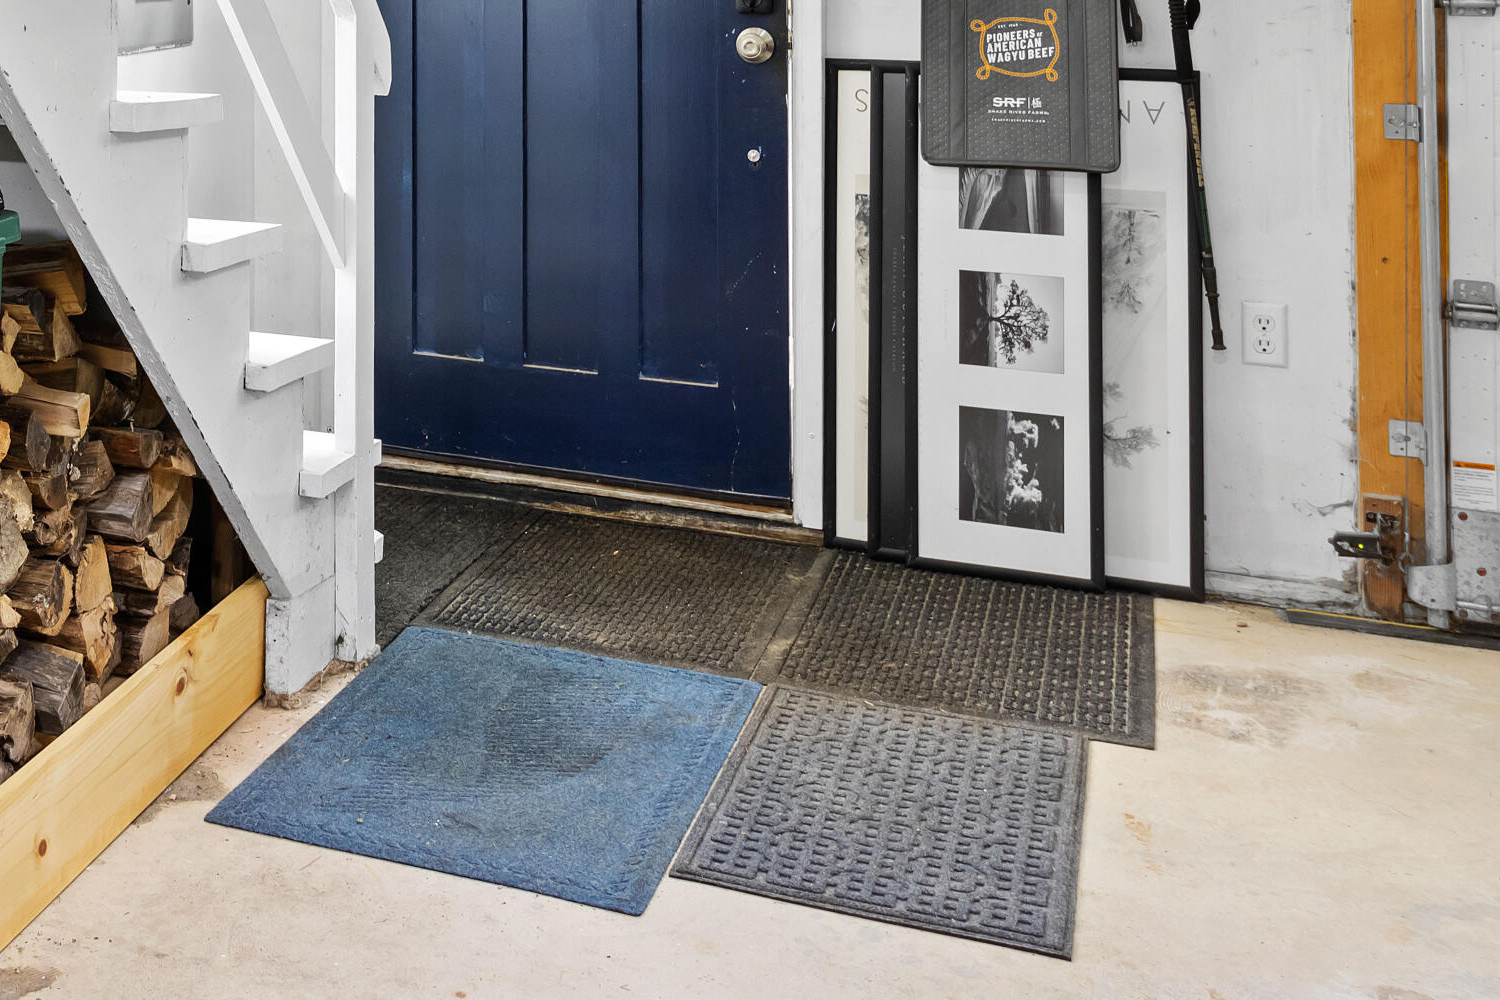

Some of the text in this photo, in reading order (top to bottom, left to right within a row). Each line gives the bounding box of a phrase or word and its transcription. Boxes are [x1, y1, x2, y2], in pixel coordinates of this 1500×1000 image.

[986, 28, 1035, 43] PIONEERS
[986, 37, 1042, 53] AMERICAN
[987, 47, 1055, 63] WAGYU BEEF
[992, 96, 1027, 107] SRF
